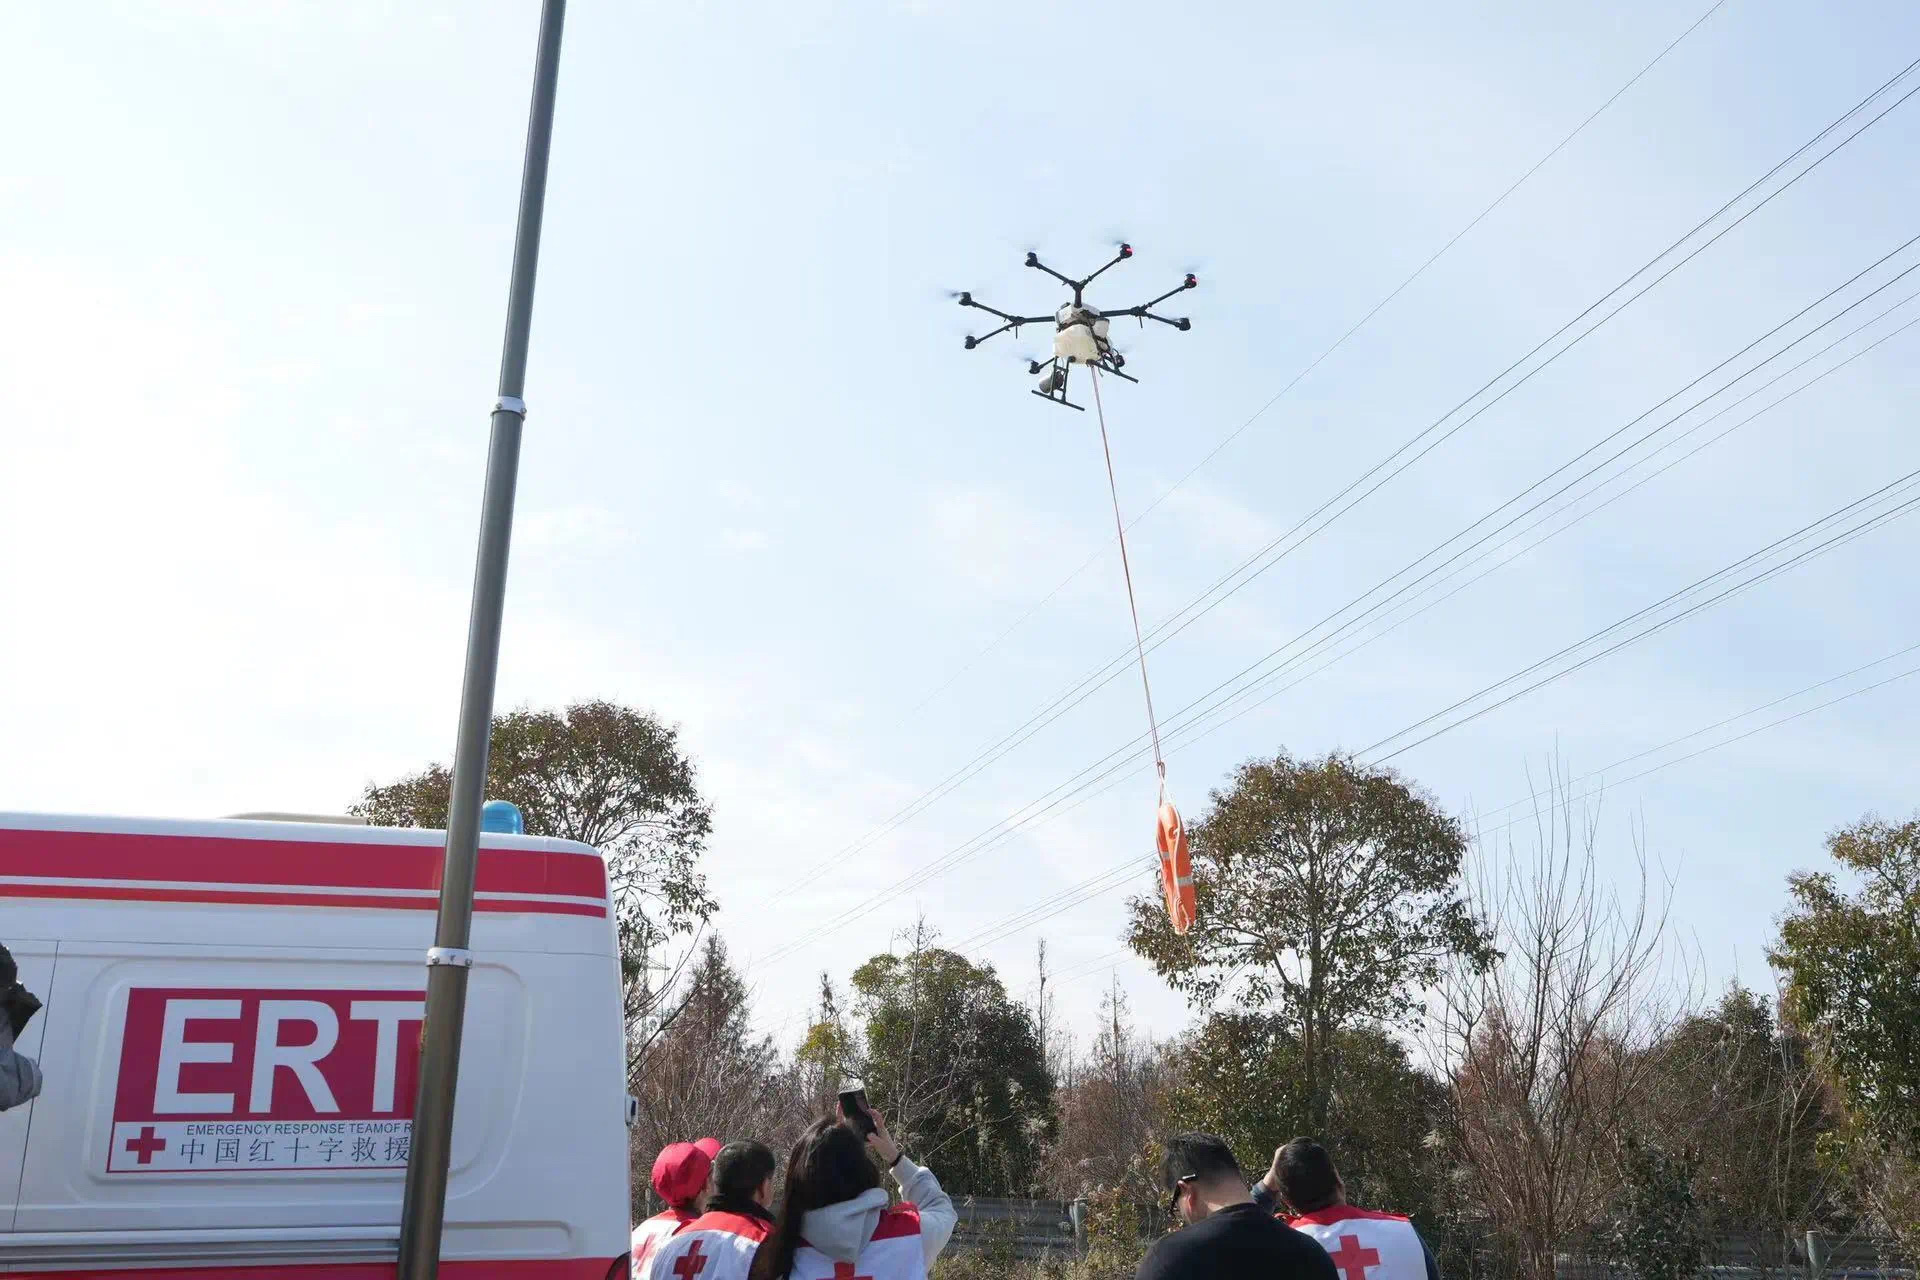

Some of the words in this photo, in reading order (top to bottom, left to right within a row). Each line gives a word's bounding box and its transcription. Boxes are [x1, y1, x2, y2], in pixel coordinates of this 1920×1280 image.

[153, 999, 427, 1114] ERT
[186, 1124, 272, 1136] EMERGENCY
[274, 1123, 346, 1135] RESPONSE
[180, 1136, 410, 1164] 中国红十字救援
